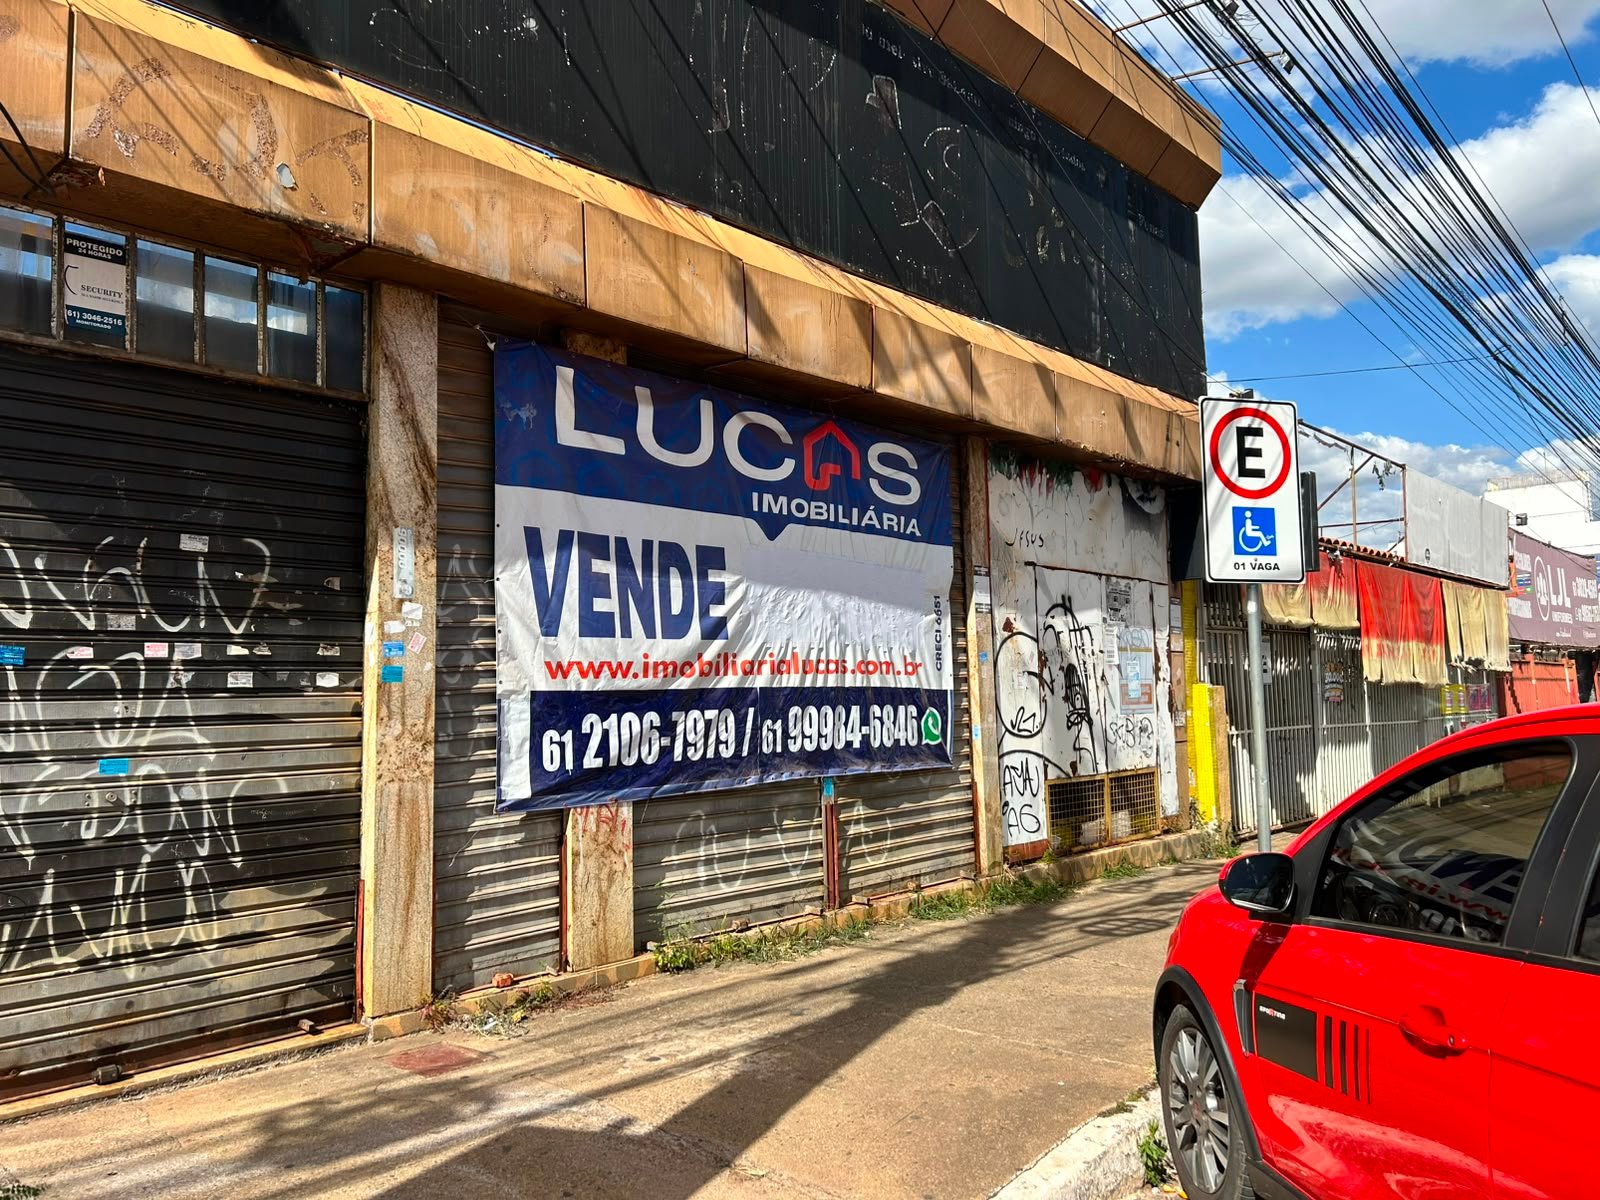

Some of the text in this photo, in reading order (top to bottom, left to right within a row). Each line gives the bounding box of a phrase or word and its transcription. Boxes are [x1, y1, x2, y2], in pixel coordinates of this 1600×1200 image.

[66, 238, 123, 257] PROTEGIDO
[88, 249, 112, 260] HORAS
[81, 284, 123, 299] SECURITY
[554, 365, 922, 506] LUCAS
[1235, 425, 1266, 479] E
[751, 491, 922, 537] IMOBILIÁRIA
[523, 525, 729, 641] VENDE
[1233, 561, 1281, 571] 01 VAGA
[933, 595, 943, 672] CRECI 6651
[544, 652, 923, 680] www.imobiliarialucas.com.br
[541, 728, 574, 774] 61
[581, 707, 736, 769] 2106-7979
[761, 718, 783, 755] 61
[787, 704, 918, 752] 99984-6846
